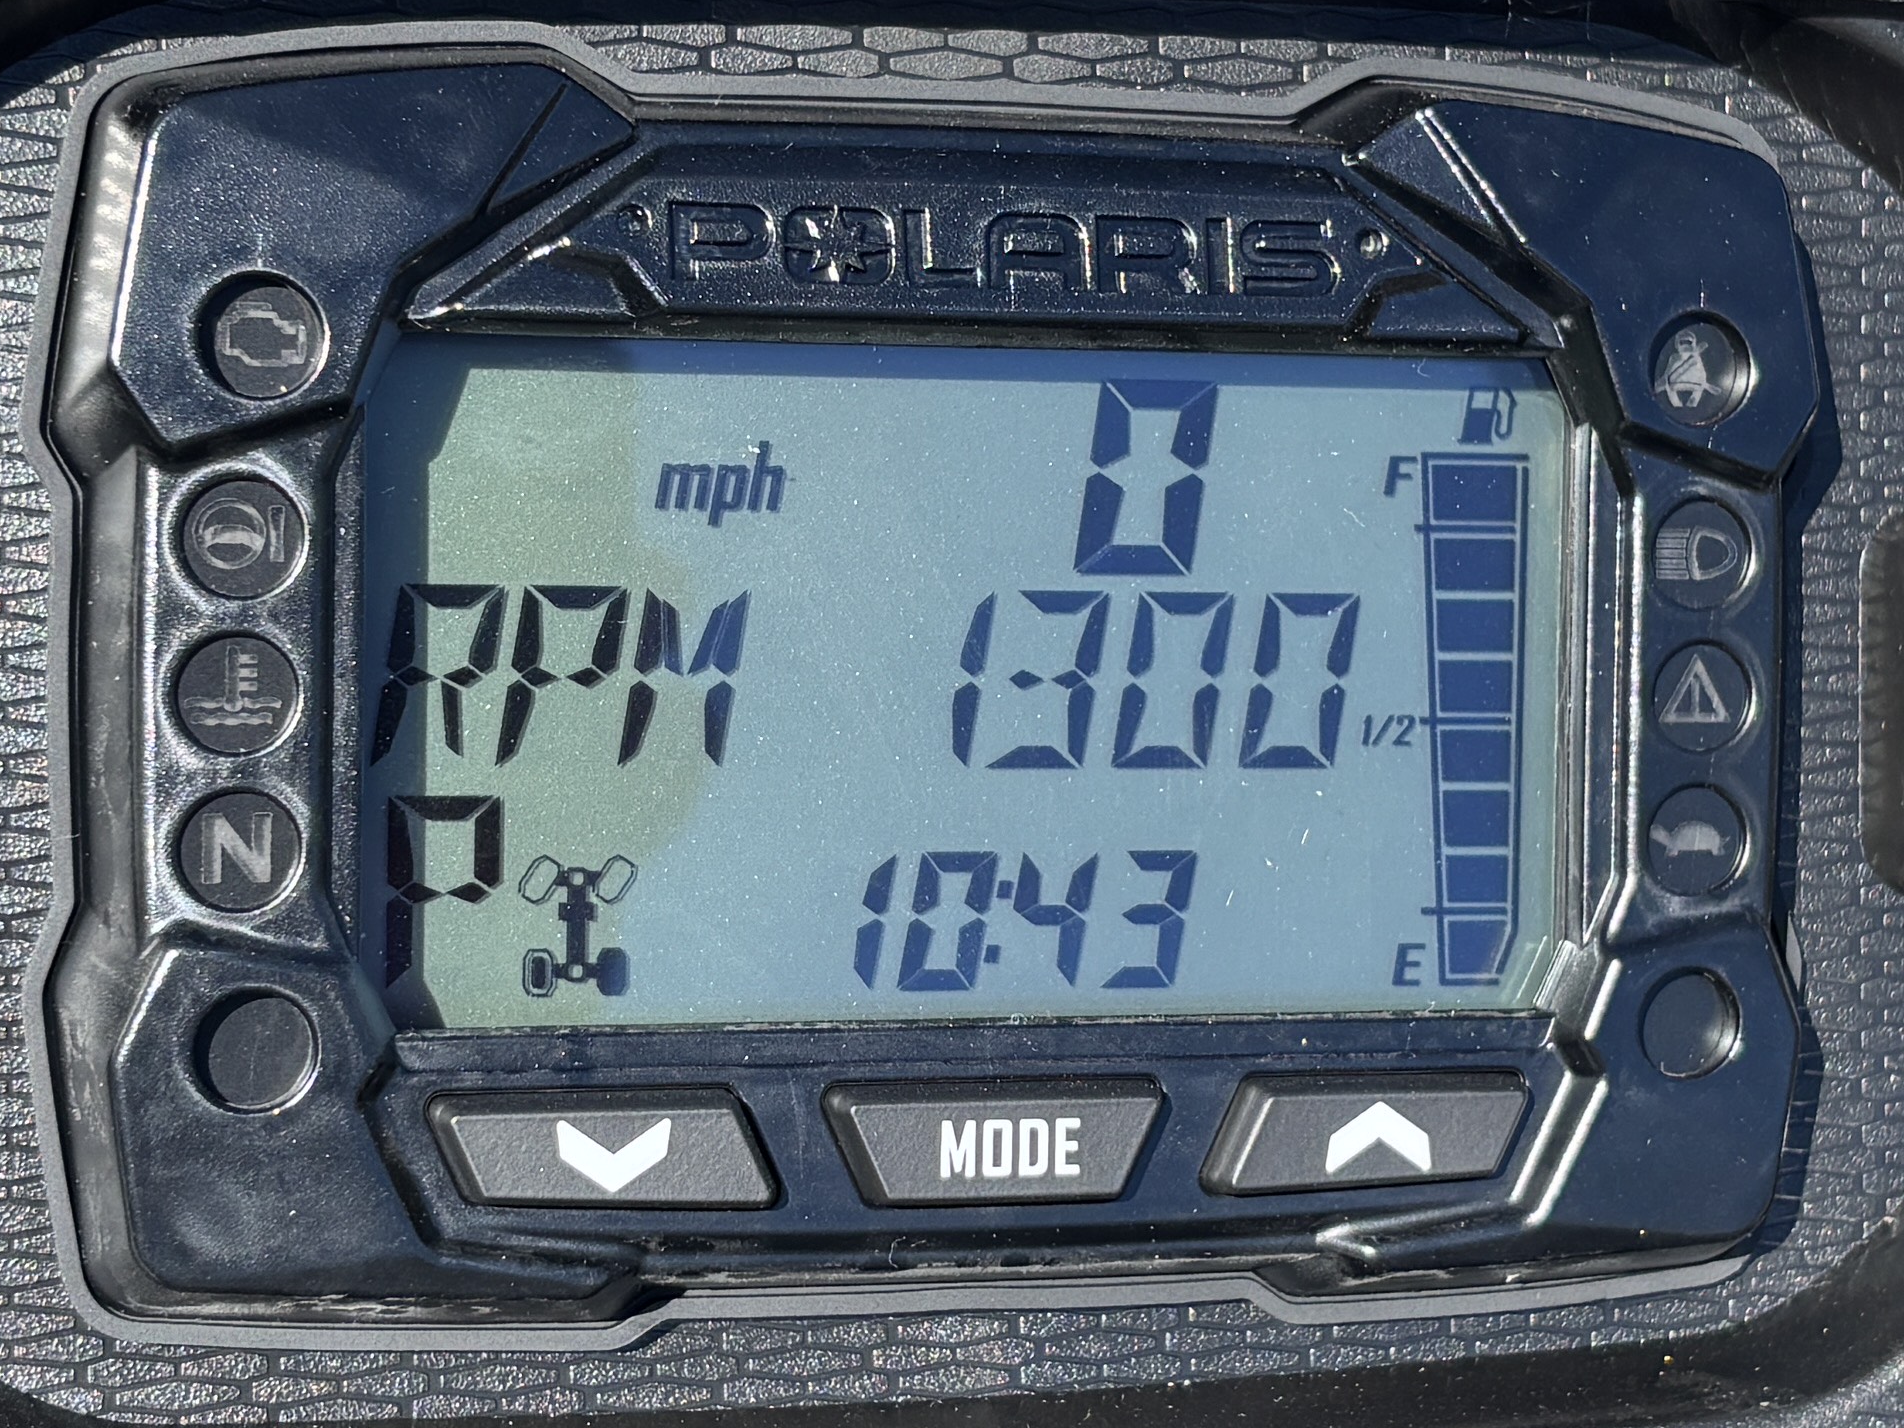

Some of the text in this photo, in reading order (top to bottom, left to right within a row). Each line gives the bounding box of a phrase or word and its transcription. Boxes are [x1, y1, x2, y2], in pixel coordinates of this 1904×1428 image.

[667, 198, 1342, 298] POLARIS
[655, 378, 1219, 576] mph 0
[1383, 455, 1418, 498] F
[369, 584, 1361, 769] RPM 1300
[1360, 714, 1416, 748] 1/2
[201, 811, 274, 885] N
[385, 795, 1198, 992] P 10:43
[1391, 942, 1427, 987] E
[939, 1116, 1082, 1179] MODE
